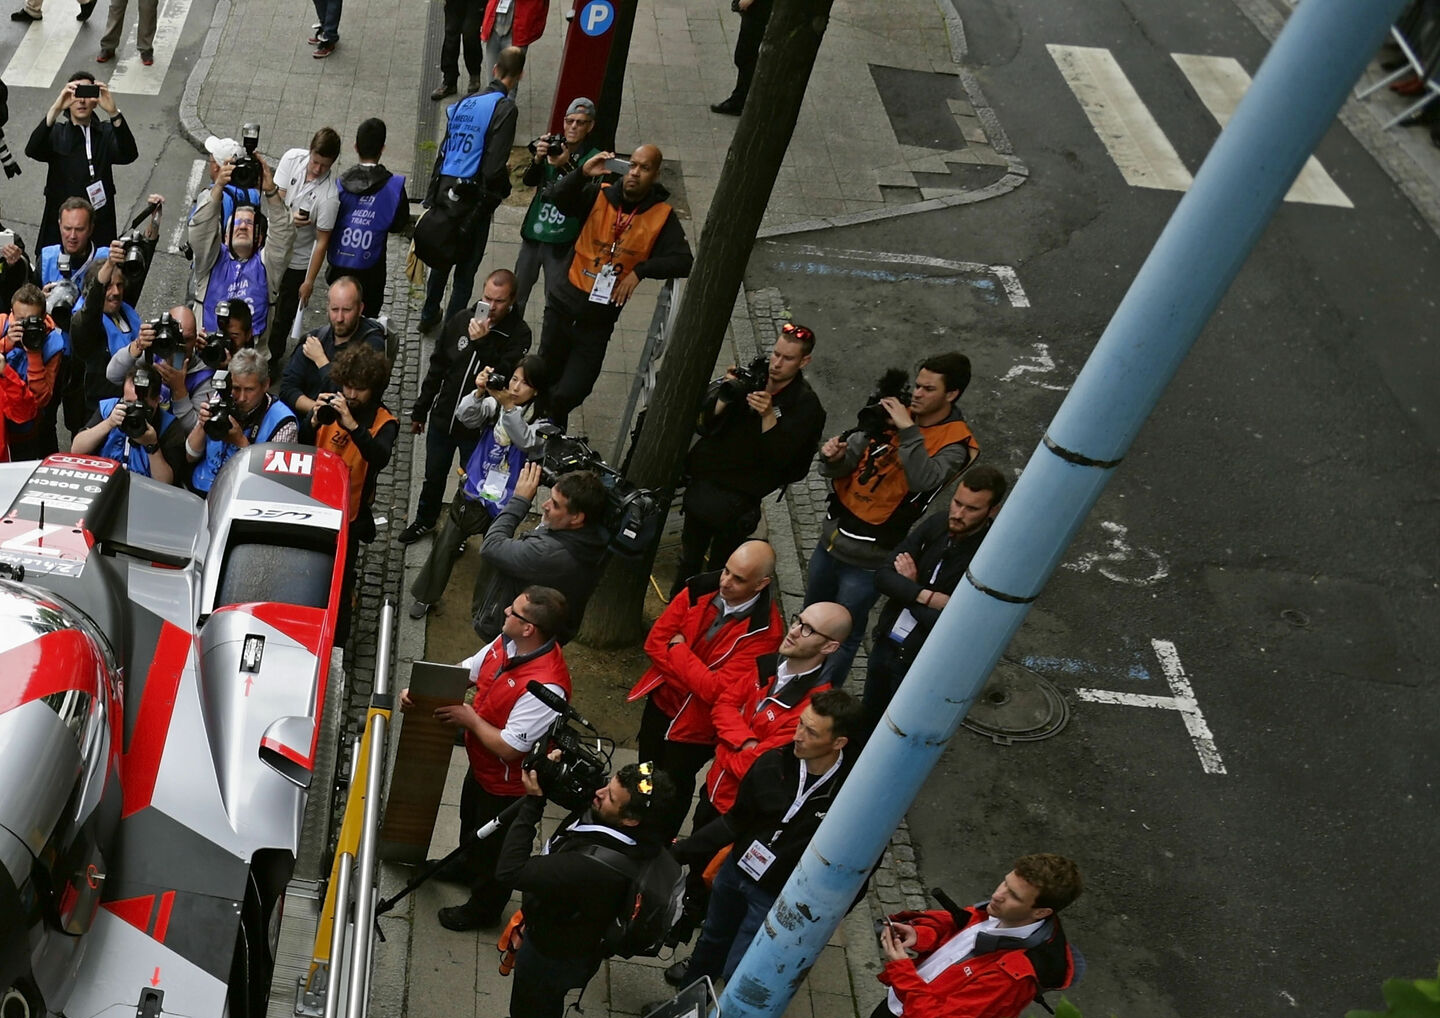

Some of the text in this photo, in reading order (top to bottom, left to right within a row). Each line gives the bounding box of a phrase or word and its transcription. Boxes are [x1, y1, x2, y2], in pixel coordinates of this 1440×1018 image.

[587, 4, 609, 31] P
[351, 216, 372, 226] TRACK
[352, 208, 376, 219] MEDIA
[340, 227, 373, 250] 890
[264, 451, 313, 475] HY
[35, 466, 110, 484] MAHLE
[28, 478, 80, 490] BOSCH
[23, 490, 94, 505] EDGE
[244, 508, 313, 521] WEC
[0, 522, 65, 556] 7
